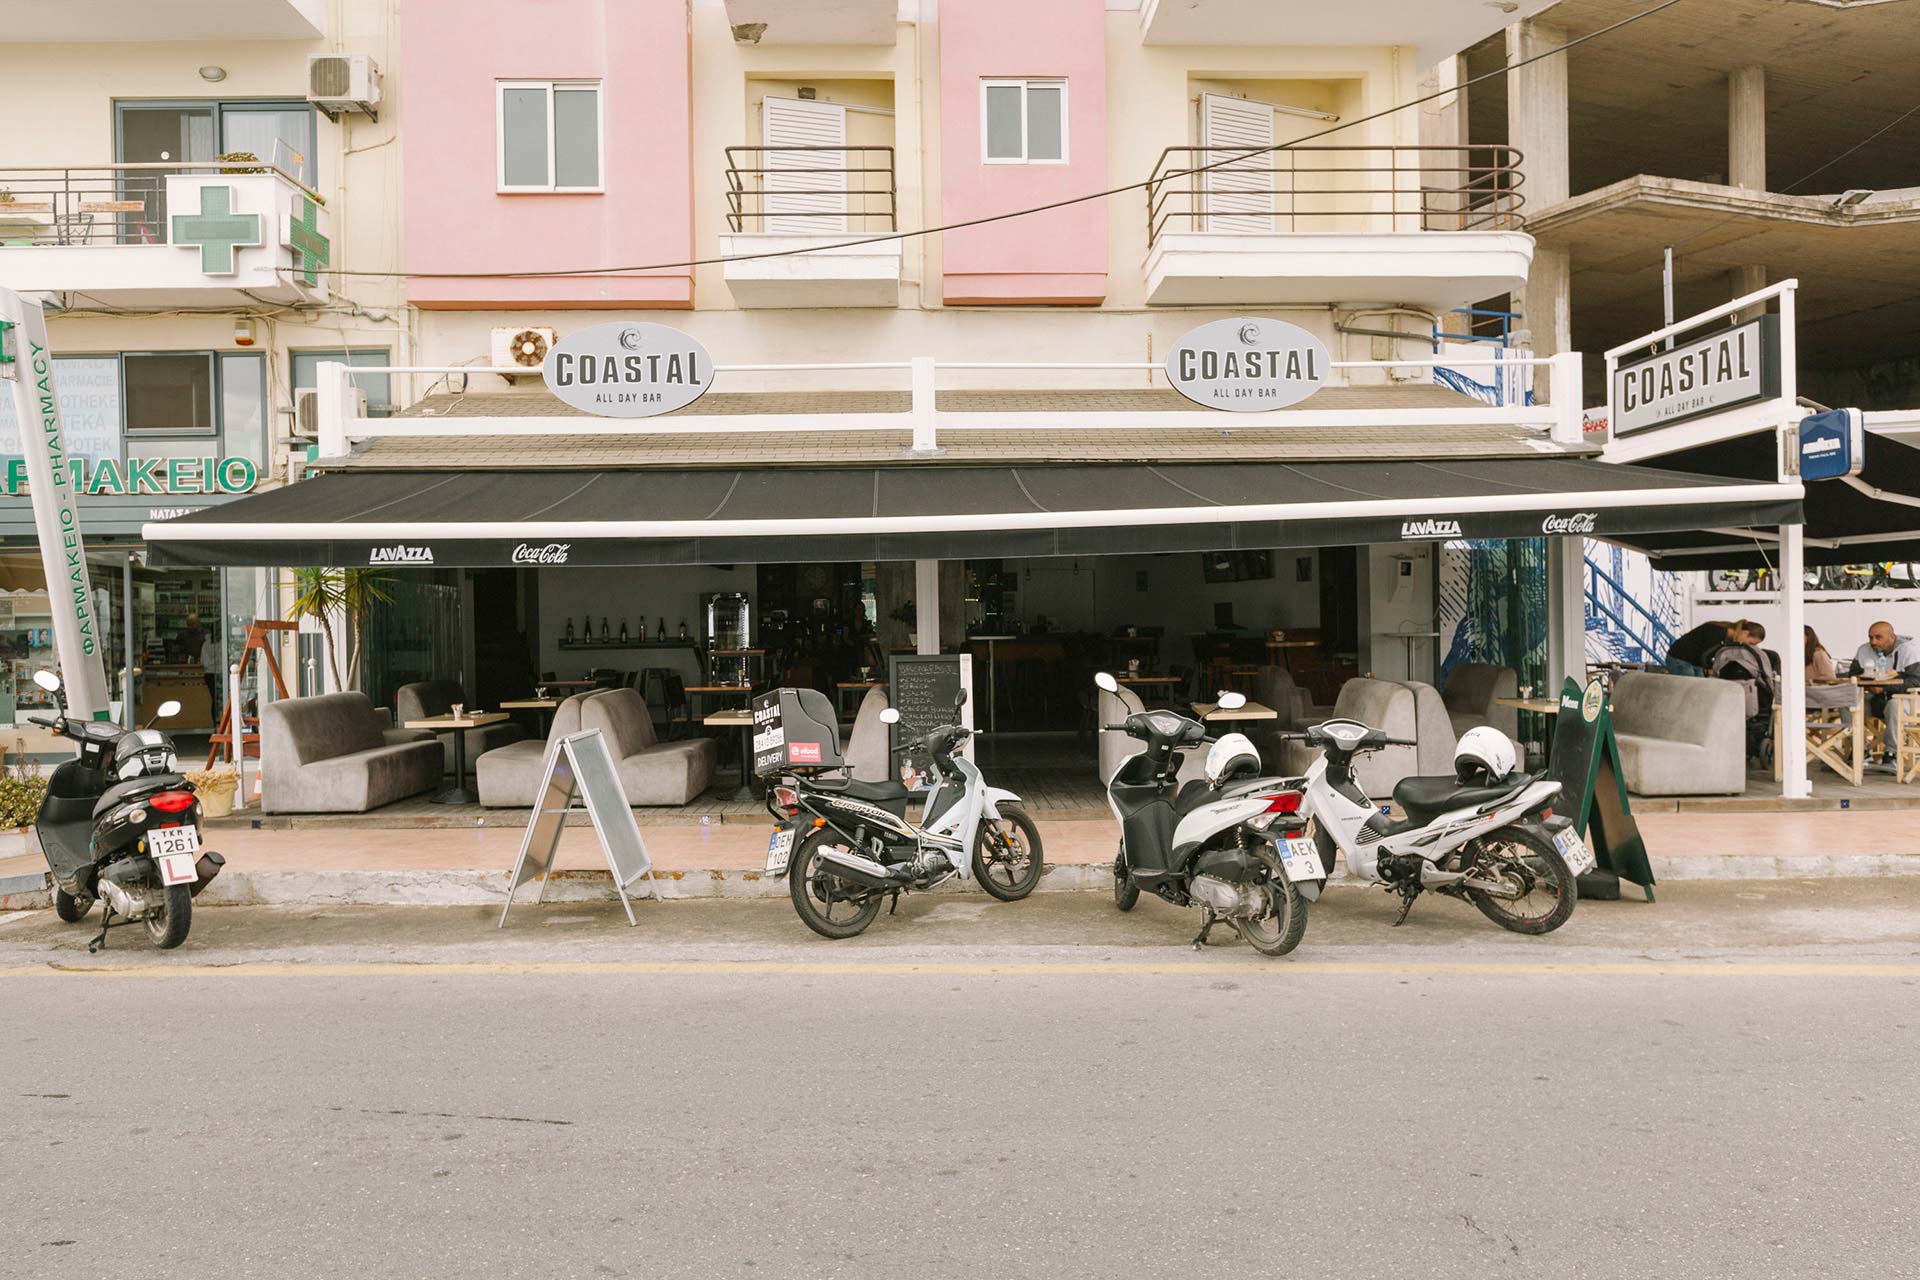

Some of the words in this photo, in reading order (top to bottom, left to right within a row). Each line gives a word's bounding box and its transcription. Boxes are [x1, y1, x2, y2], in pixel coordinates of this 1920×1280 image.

[556, 352, 701, 387] COASTAL
[1179, 349, 1319, 382] COASTAL
[1624, 331, 1750, 414] COASTAL
[595, 393, 613, 403] ALL
[618, 393, 637, 403] DAY
[643, 393, 662, 403] BAR
[1213, 388, 1230, 398] ALL
[1235, 388, 1253, 398] DAY
[1258, 388, 1277, 398] BAR
[30, 341, 66, 487] PHARMACY
[1664, 406, 1675, 416] ALL
[1677, 402, 1689, 413] DAY
[1692, 397, 1705, 409] BAR
[0, 456, 258, 494] ΡΜΑΚΕΙΟ
[1401, 518, 1462, 536] LAVAZZA
[1541, 512, 1599, 534] Coca-Cola
[369, 544, 434, 562] LAVAZZA
[512, 543, 572, 564] Coca-Cola
[754, 704, 781, 724] COASTAL
[757, 752, 783, 768] DELIVERY
[161, 829, 183, 838] TKM
[155, 838, 194, 854] 1261
[1290, 842, 1317, 857] AEK
[165, 857, 193, 882] L
